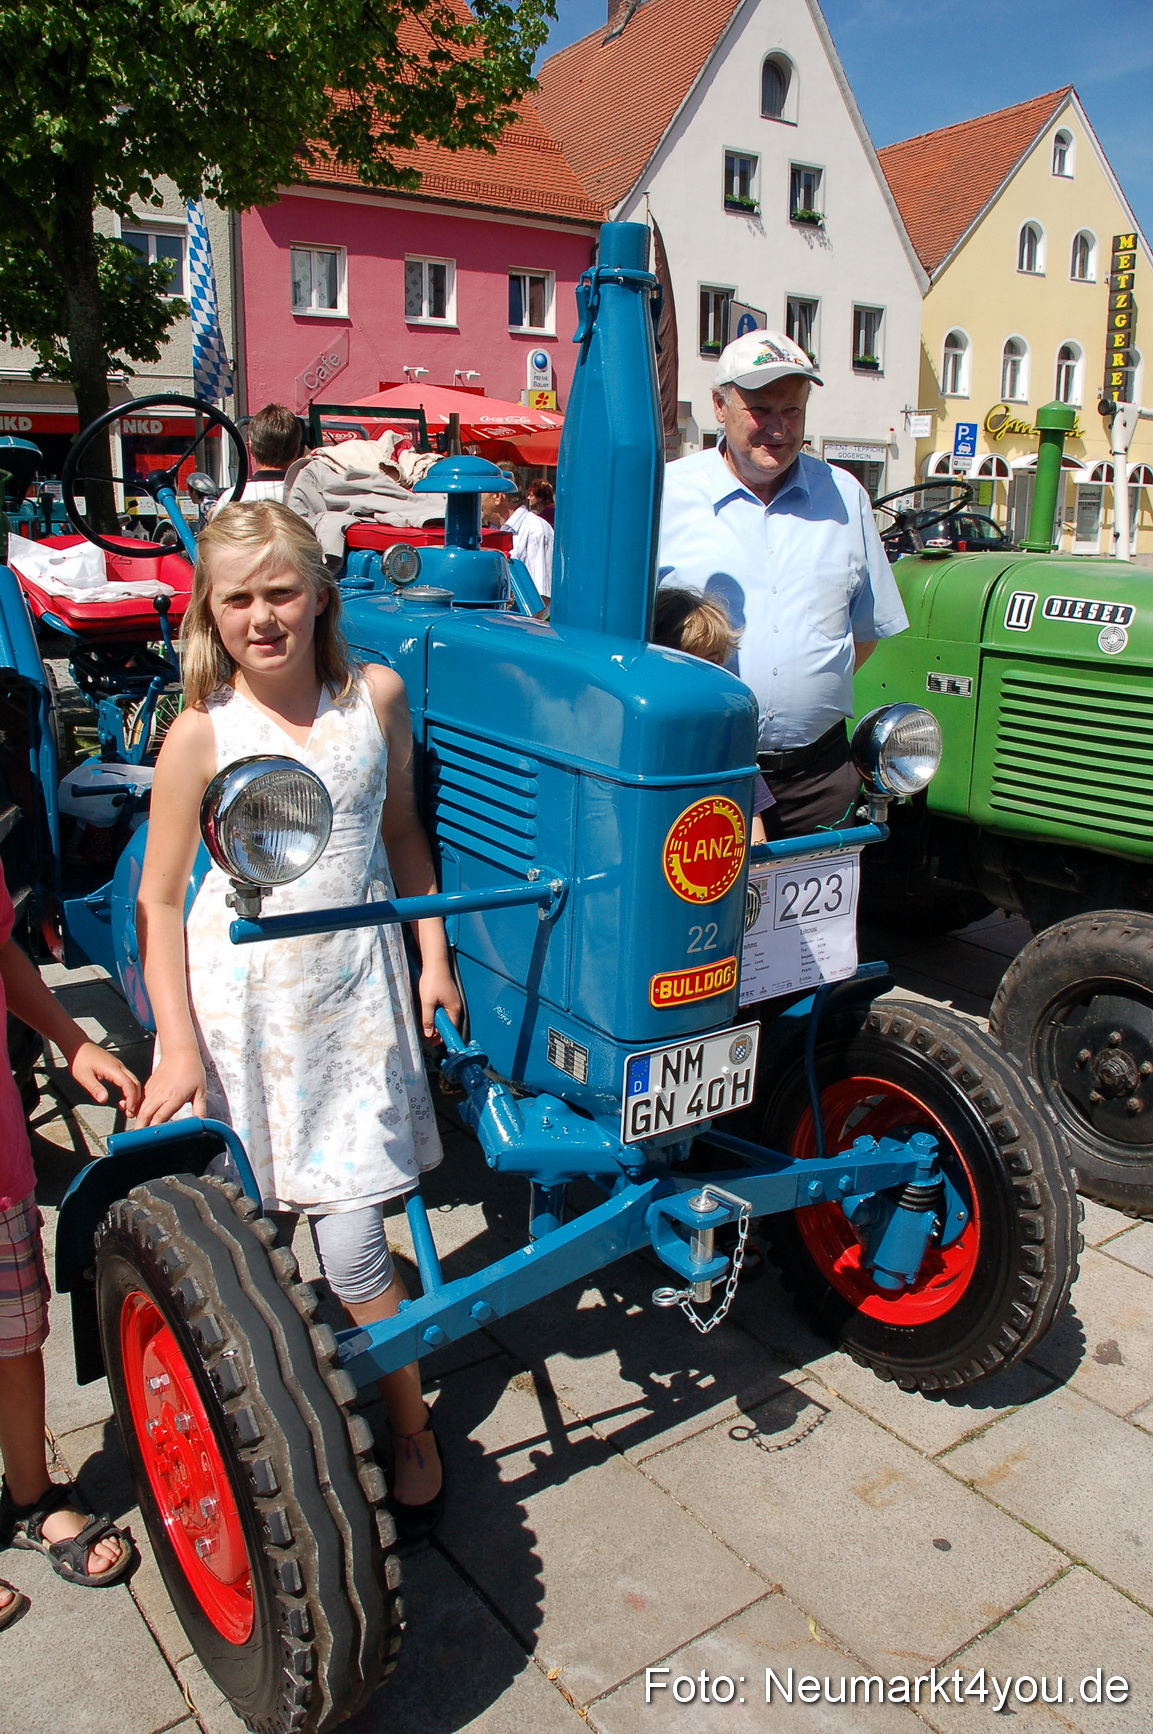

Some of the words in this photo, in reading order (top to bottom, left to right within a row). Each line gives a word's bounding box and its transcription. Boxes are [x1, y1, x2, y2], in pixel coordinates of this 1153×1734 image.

[1111, 235, 1134, 402] METZGEREI
[303, 353, 341, 390] Cafe
[0, 416, 33, 431] KD
[122, 420, 163, 434] NKD
[958, 425, 970, 441] P
[824, 443, 849, 451] ORIENT
[853, 445, 885, 454] TEPPICHE
[1050, 599, 1127, 624] DIESEL
[682, 835, 735, 864] LANZ
[779, 873, 843, 923] 223
[686, 922, 719, 954] 22
[659, 964, 733, 1000] BULLDOG
[661, 1043, 705, 1089] NM
[633, 1080, 642, 1093] D
[631, 1091, 676, 1137] GN
[686, 1068, 751, 1118] 40H
